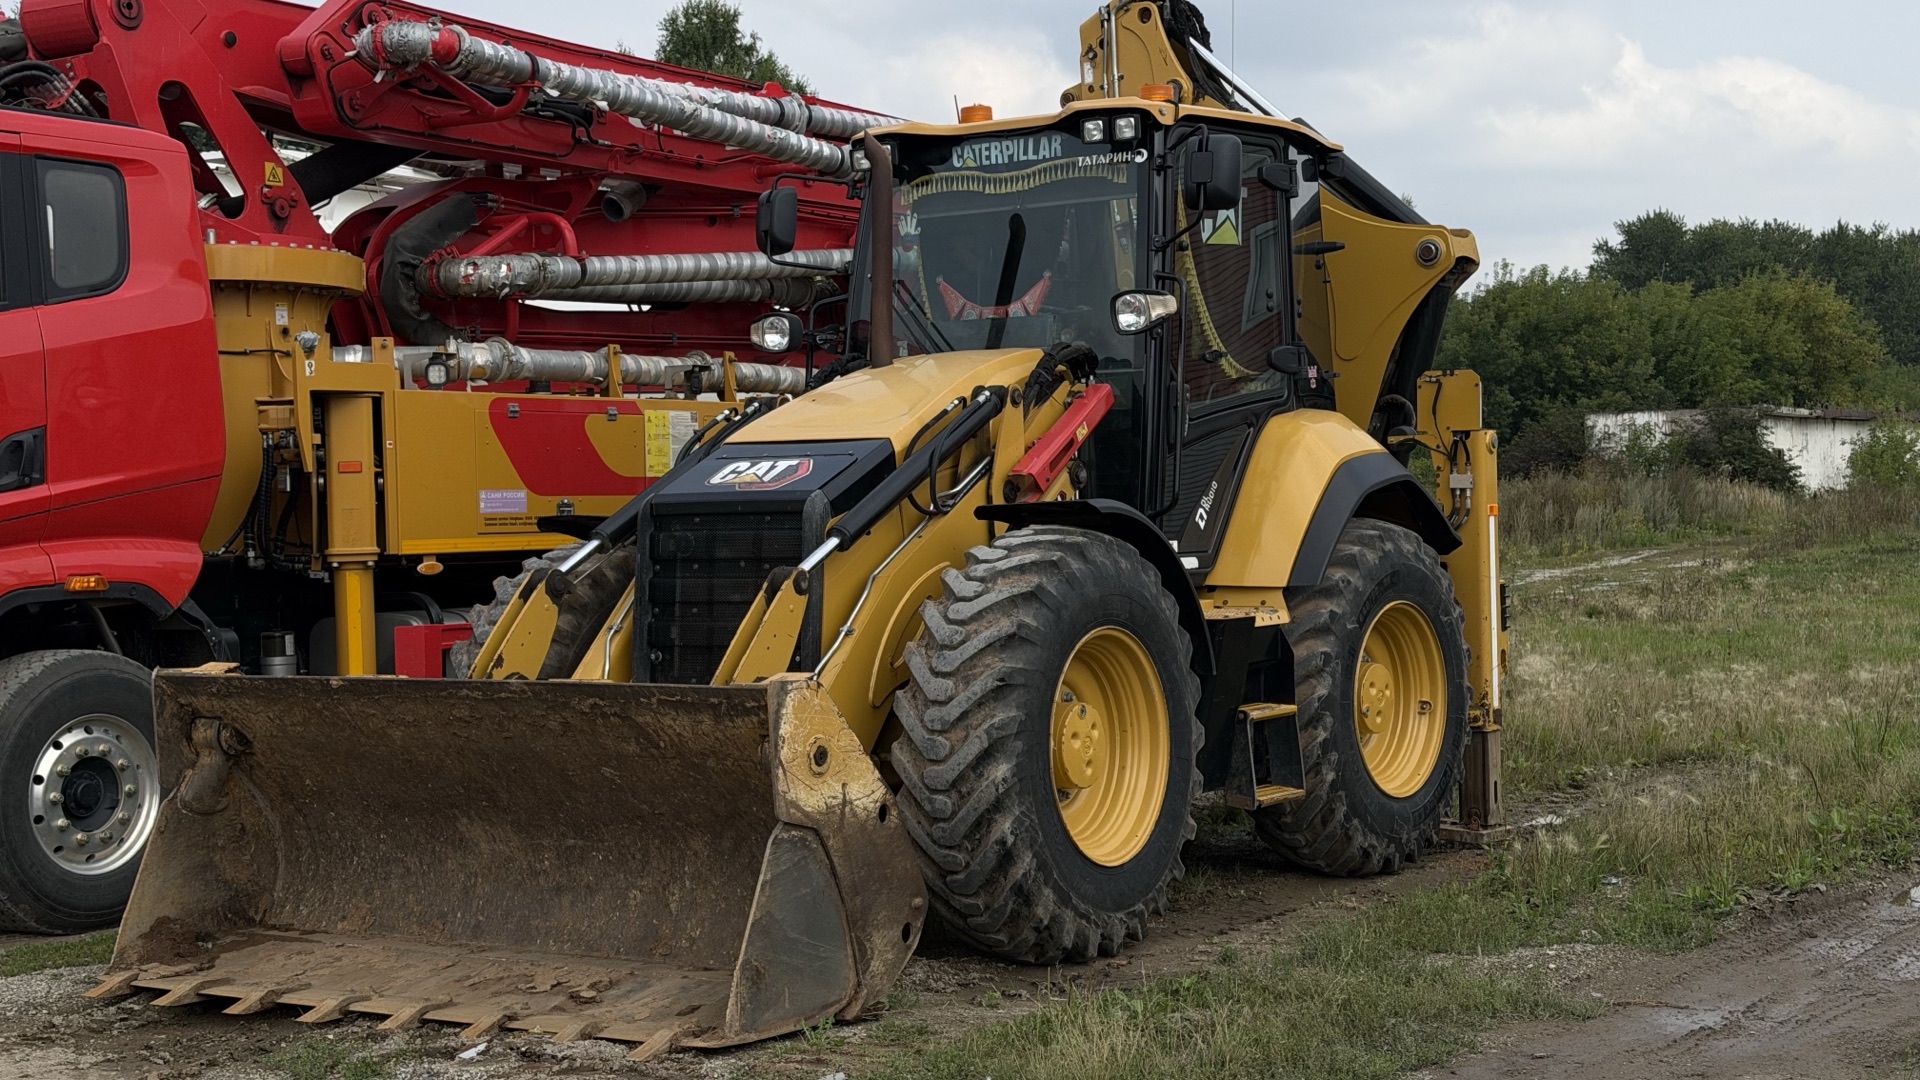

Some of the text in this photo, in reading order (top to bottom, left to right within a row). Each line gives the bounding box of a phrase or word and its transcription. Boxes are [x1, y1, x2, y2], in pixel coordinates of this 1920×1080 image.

[952, 134, 1062, 168] CATERPILLAR
[1077, 150, 1131, 167] ТАТАРИН
[709, 460, 801, 484] CAT
